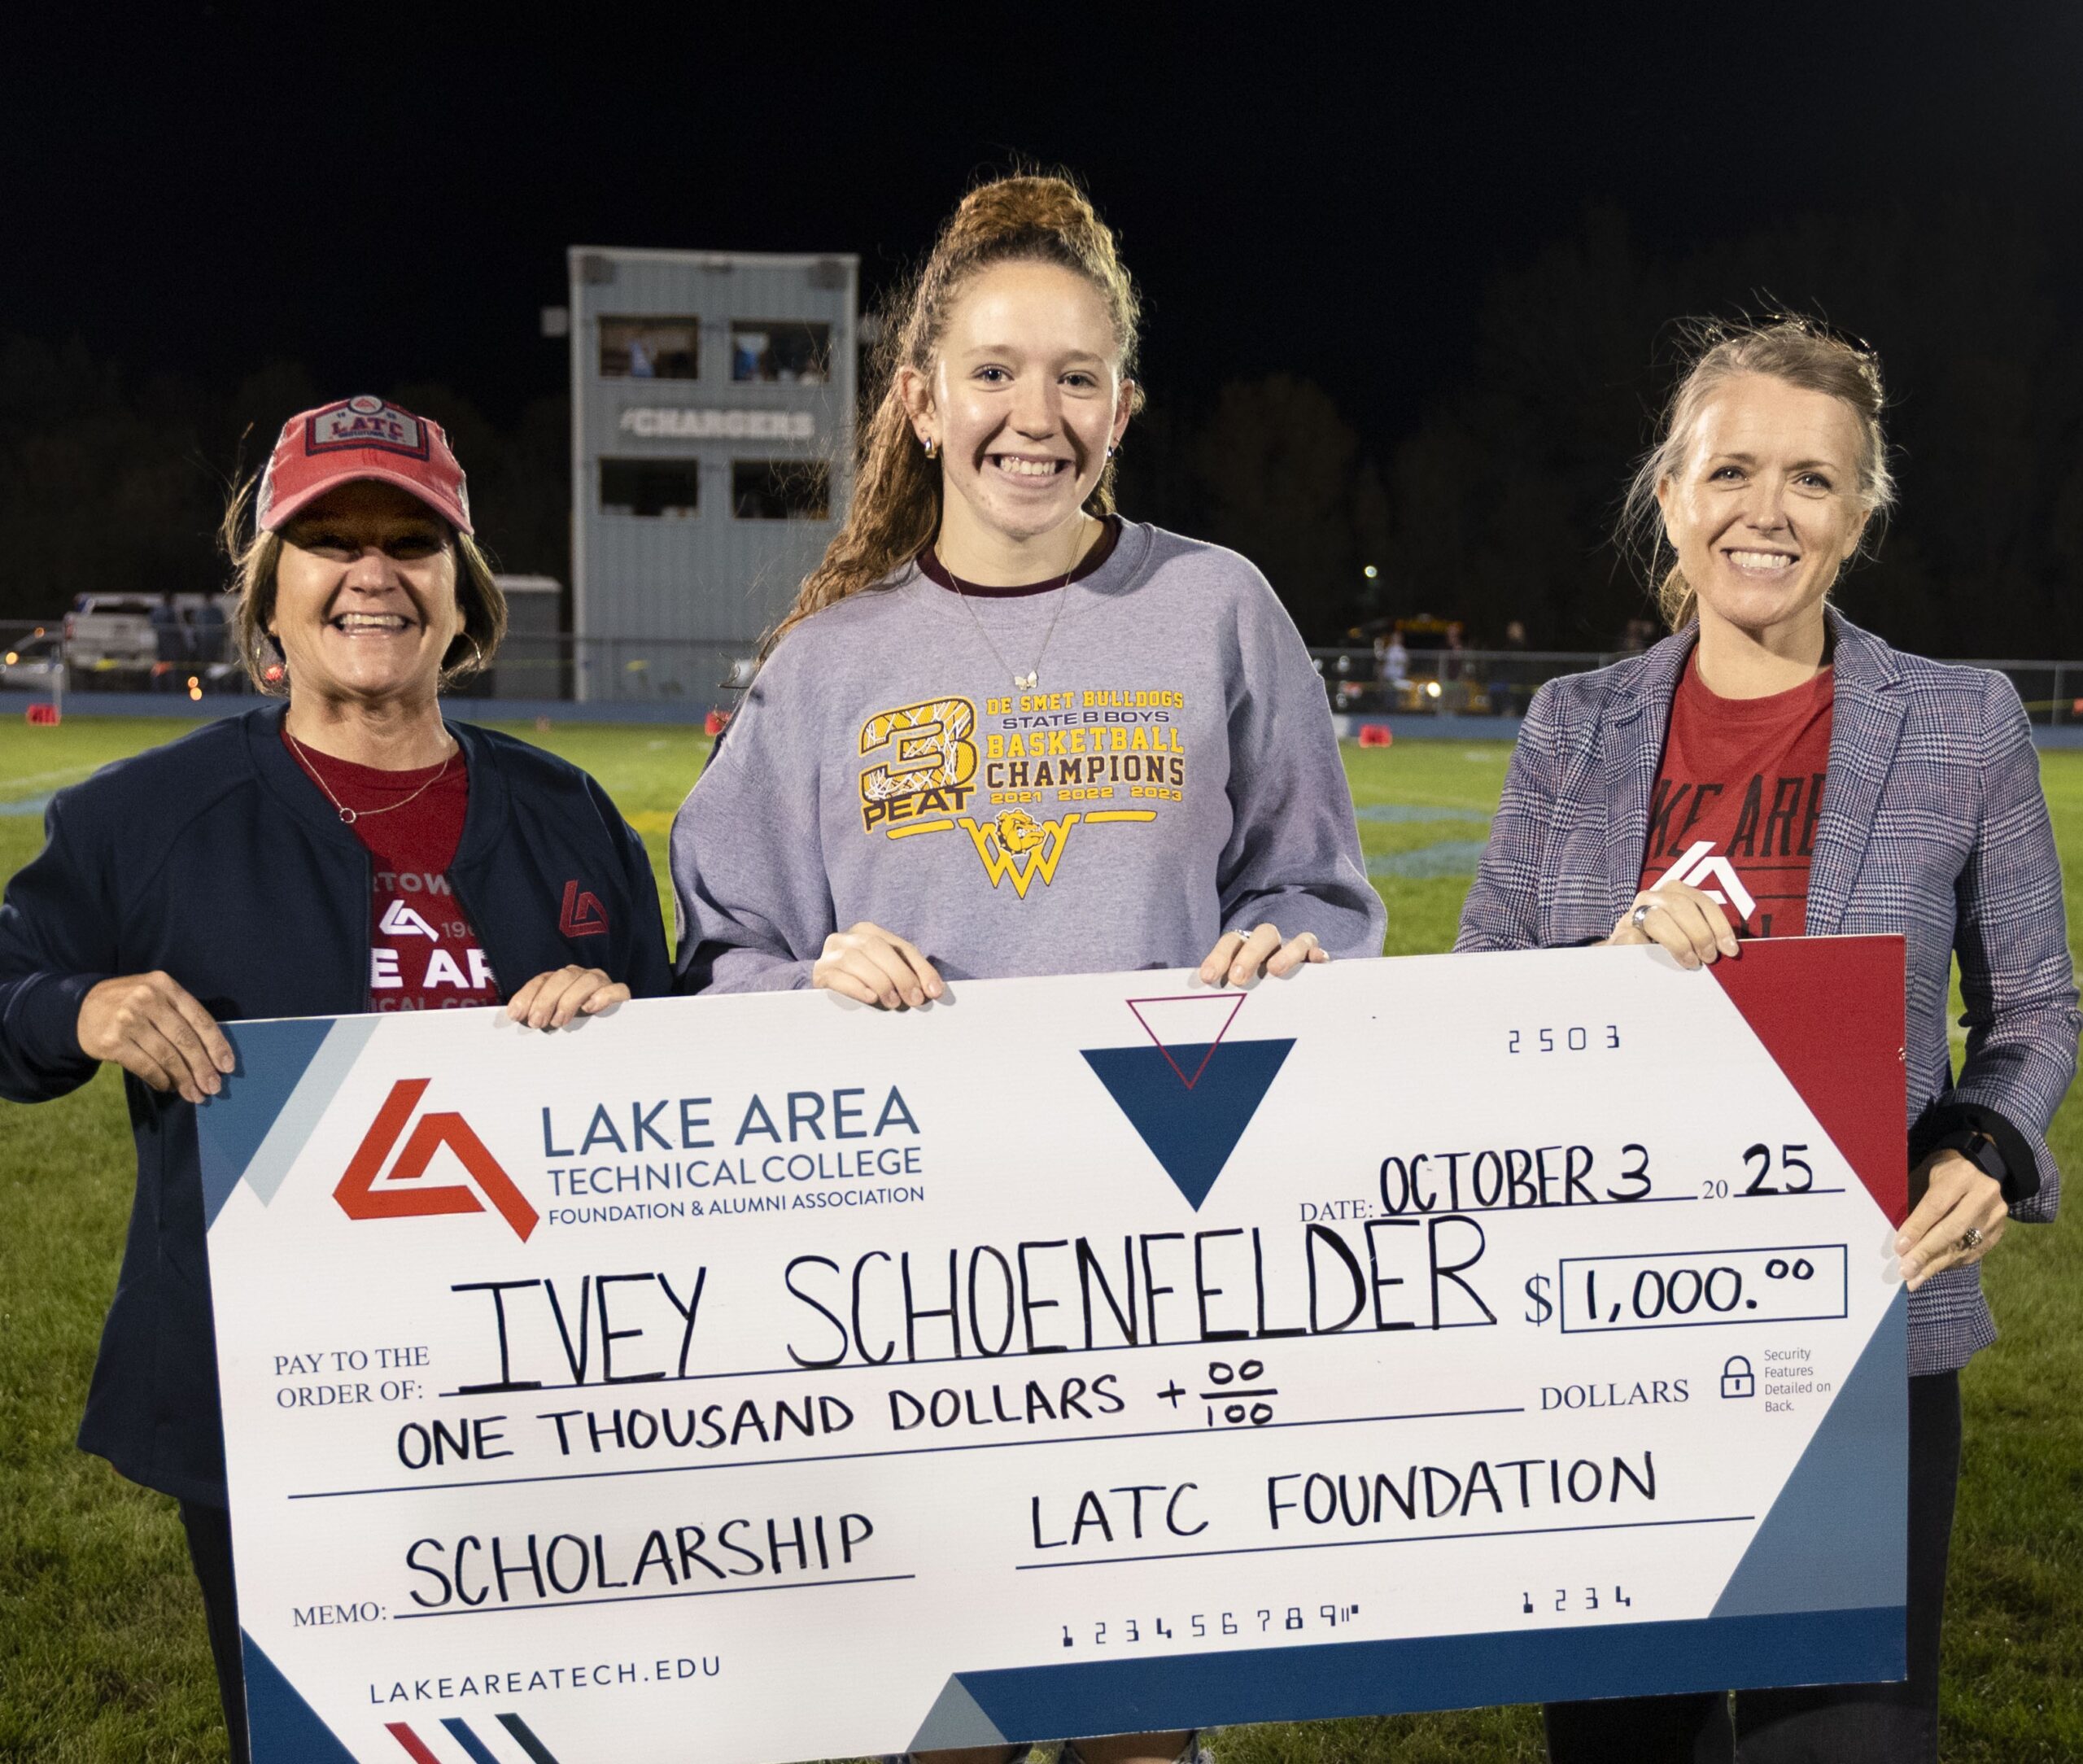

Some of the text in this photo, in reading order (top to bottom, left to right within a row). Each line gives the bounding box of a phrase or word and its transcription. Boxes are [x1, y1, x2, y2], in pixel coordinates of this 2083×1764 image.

[331, 417, 404, 437] LATC
[986, 690, 1184, 715] DE SMET BULLDOGS
[1002, 711, 1169, 729] STATE B BOYS
[986, 726, 1185, 759] BASKETBALL
[987, 754, 1184, 788] CHAMPIONS
[862, 786, 974, 832] PEAT
[990, 786, 1182, 804] 2021 2022 2023
[542, 1085, 920, 1157] LAKE AREA
[547, 1146, 922, 1196] TECHNICAL COLLEGE
[1299, 1143, 1814, 1223] DATE: OCTOBER 3 20 25
[549, 1186, 924, 1225] FOUNDATION & ALUMNI ASSOCIATION
[451, 1215, 1498, 1394] IVEY SCHOENFELDER
[274, 1346, 430, 1376] PAY TO THE
[1764, 1347, 1811, 1361] Security
[1765, 1366, 1814, 1378] Features
[1765, 1382, 1831, 1395] Detailed on
[277, 1381, 423, 1409] ORDER OF:
[1540, 1378, 1690, 1411] DOLLARS
[1765, 1399, 1795, 1413] Back.
[397, 1416, 513, 1469] ONE
[536, 1392, 854, 1457] THOUSAND
[889, 1373, 1125, 1430] DOLLARS
[1031, 1451, 1657, 1549] LATC FOUNDATION
[405, 1513, 875, 1608] SCHOLARSHIP
[293, 1603, 388, 1628] MEMO:
[369, 1655, 723, 1705] LAKEAREATECH.EDU
